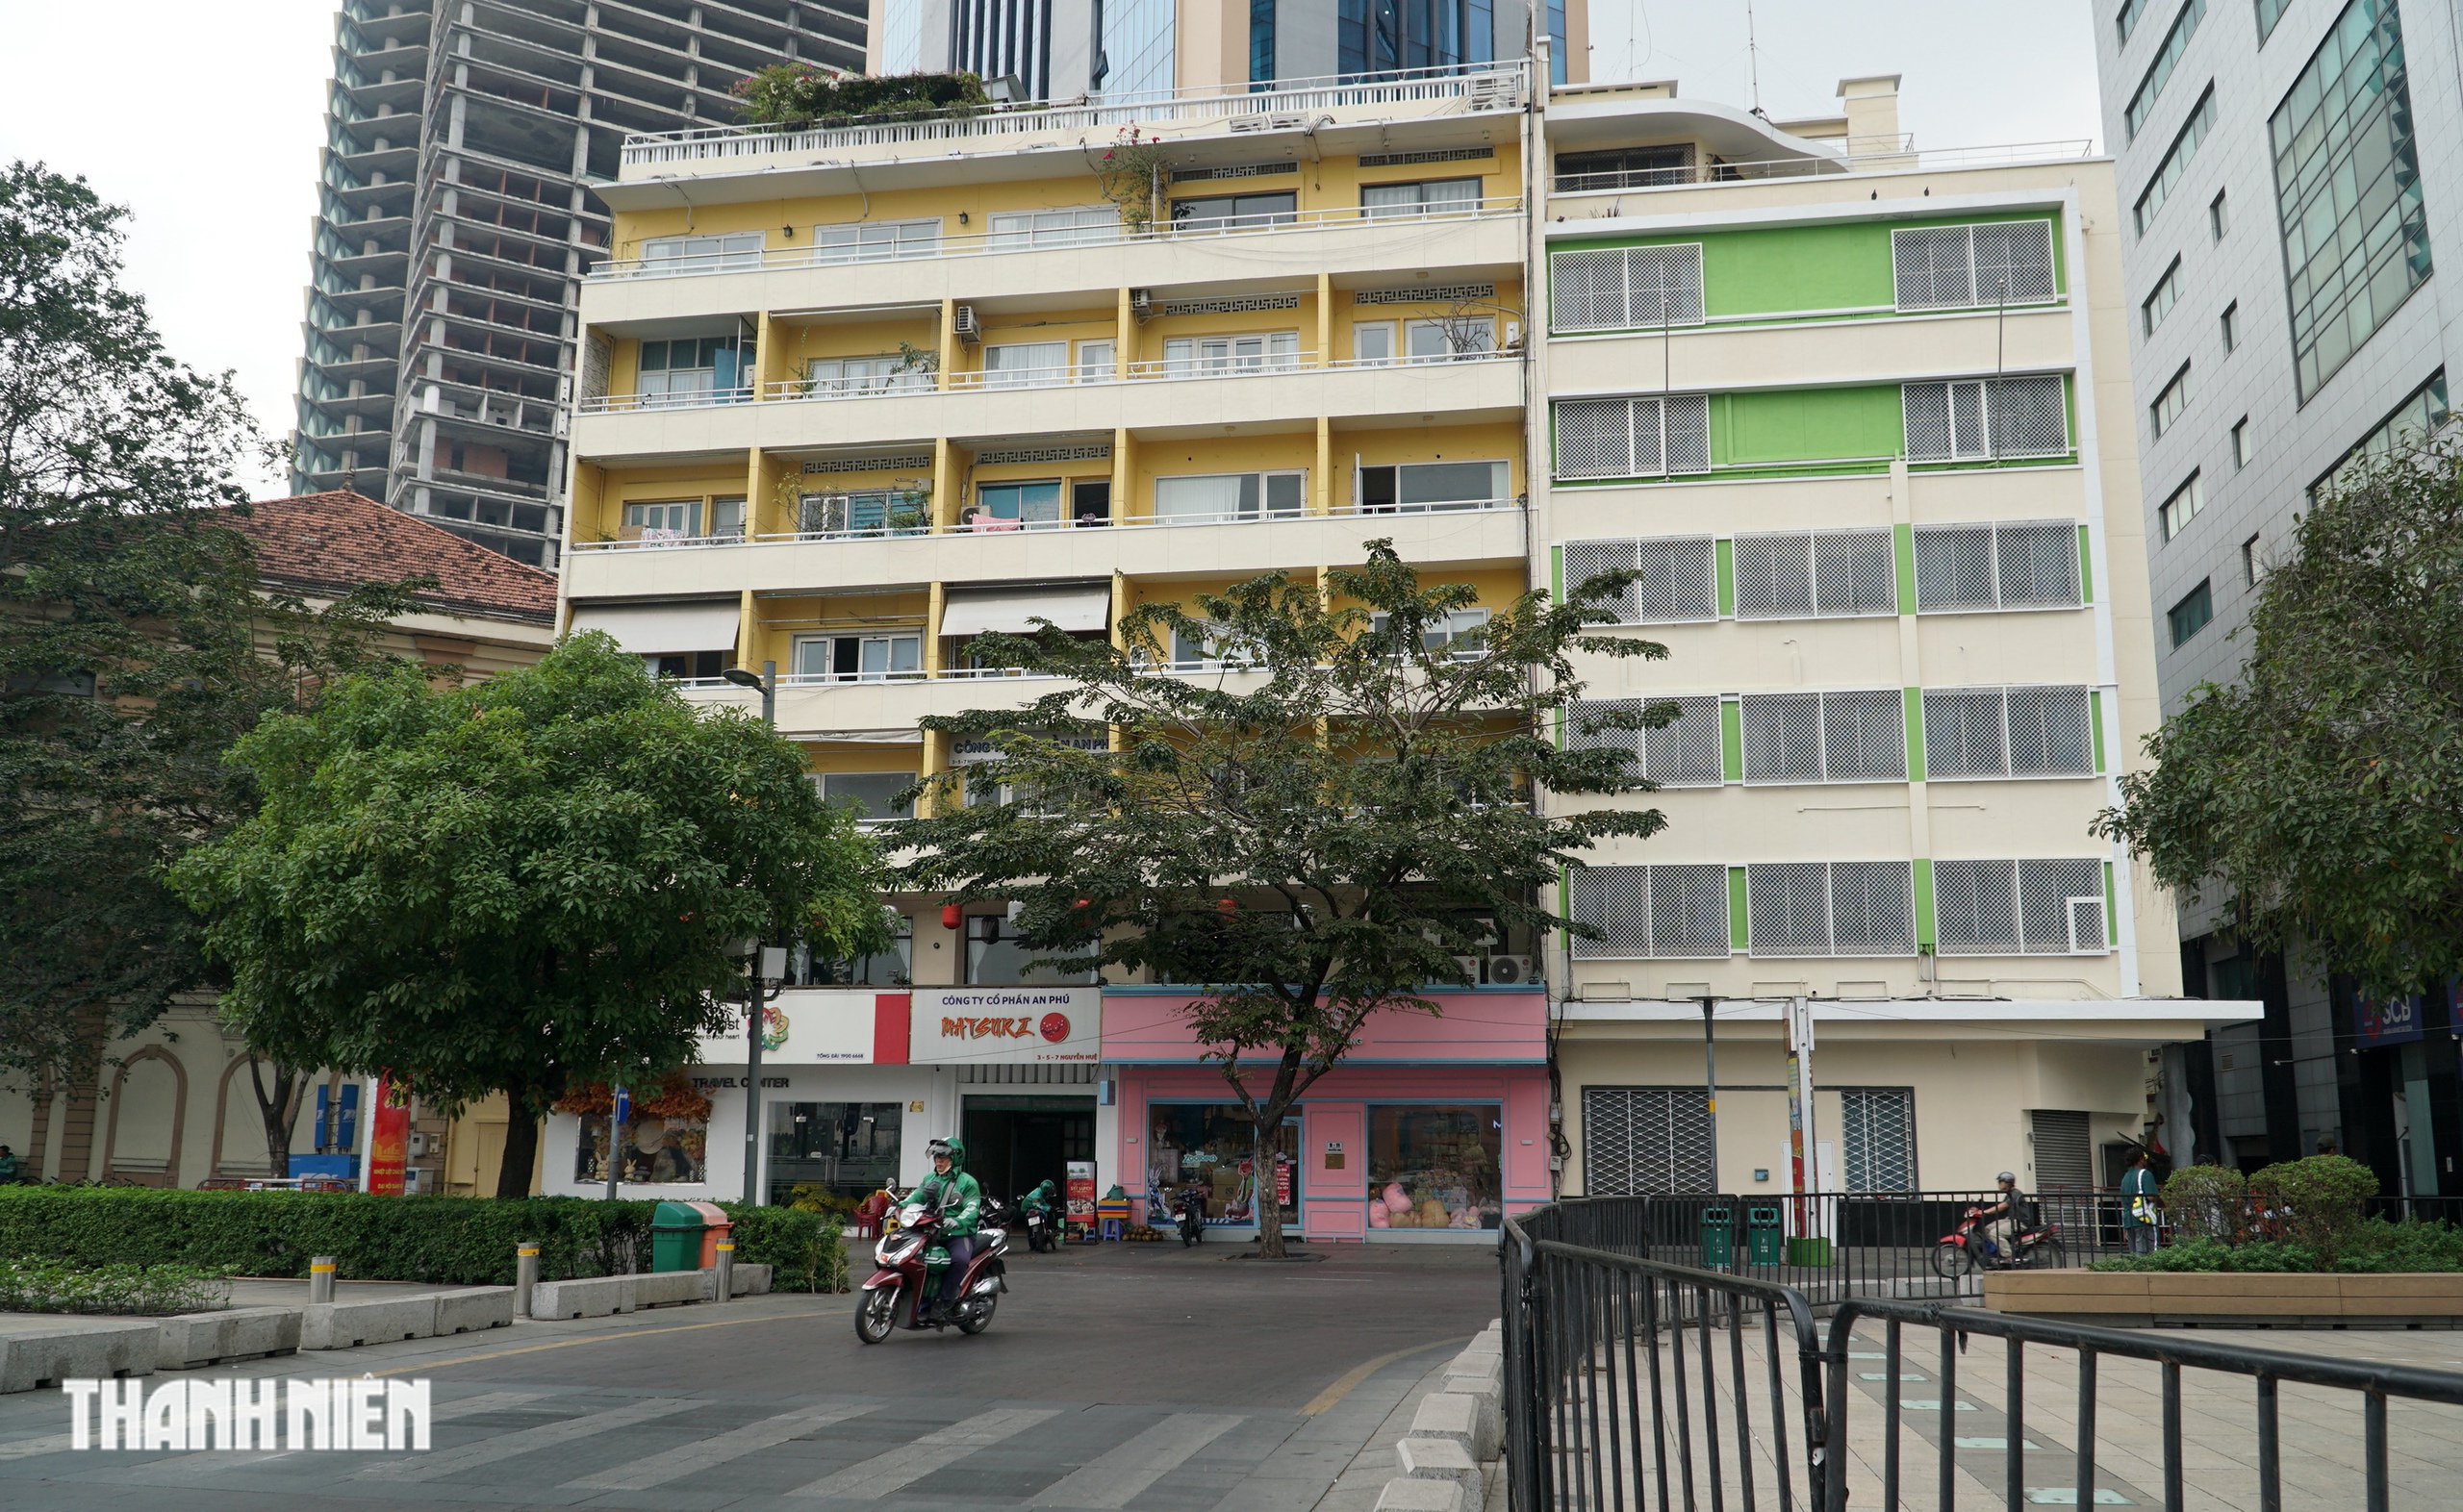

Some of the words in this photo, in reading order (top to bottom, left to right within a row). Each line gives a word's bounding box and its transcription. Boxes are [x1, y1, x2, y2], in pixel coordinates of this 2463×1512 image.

[953, 740, 990, 753] CÔNG
[1092, 739, 1109, 750] PH
[942, 995, 970, 1005] CÔNG
[972, 995, 984, 1005] TY
[986, 993, 1001, 1005] CỔ
[1032, 995, 1046, 1004] AN
[1049, 993, 1070, 1004] PHÚ
[2382, 994, 2411, 1024] SCB
[941, 1016, 1035, 1040] MATSURI
[1085, 1052, 1098, 1061] HUỆ
[693, 1077, 738, 1088] TRAVEL
[741, 1077, 789, 1088] CNTER
